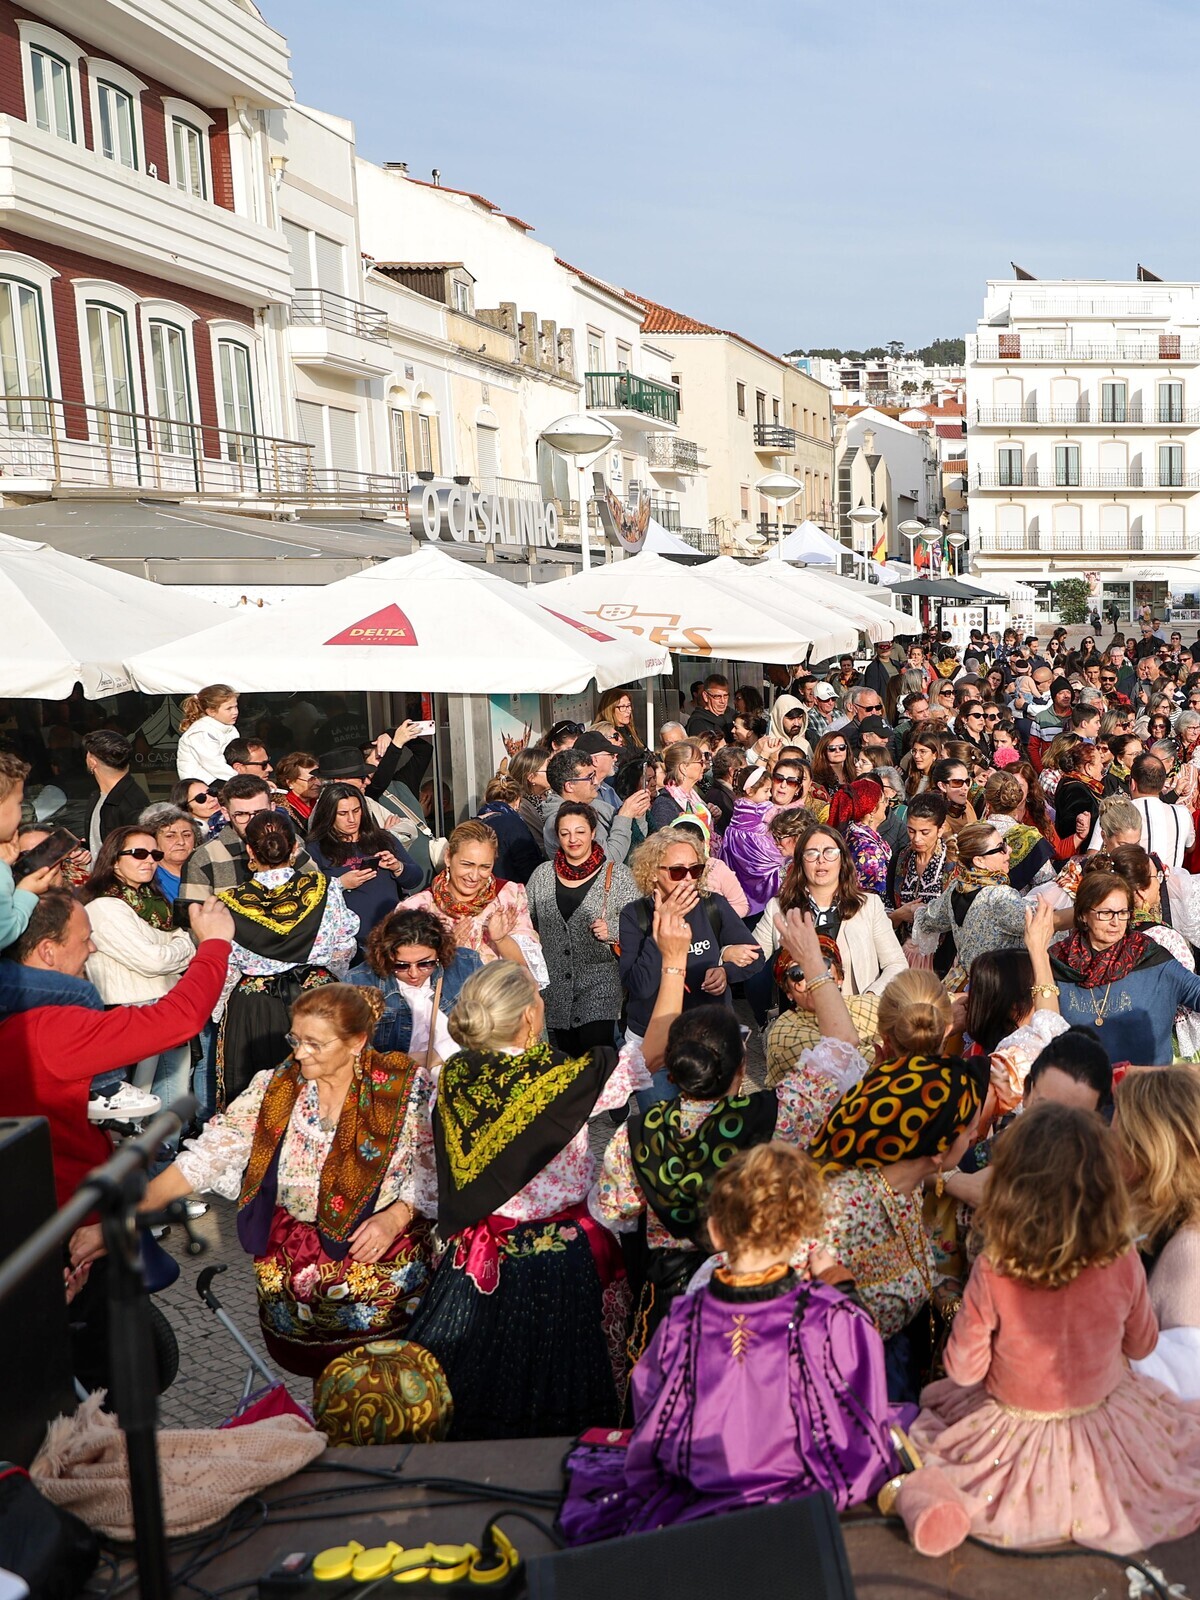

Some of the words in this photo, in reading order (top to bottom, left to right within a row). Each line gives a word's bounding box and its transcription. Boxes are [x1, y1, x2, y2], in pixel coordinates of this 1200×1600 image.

[422, 484, 441, 542] O
[448, 487, 559, 548] CASALINHO
[349, 628, 406, 637] DELTA
[135, 752, 144, 763] O
[147, 752, 177, 763] CASA
[688, 939, 711, 956] nge
